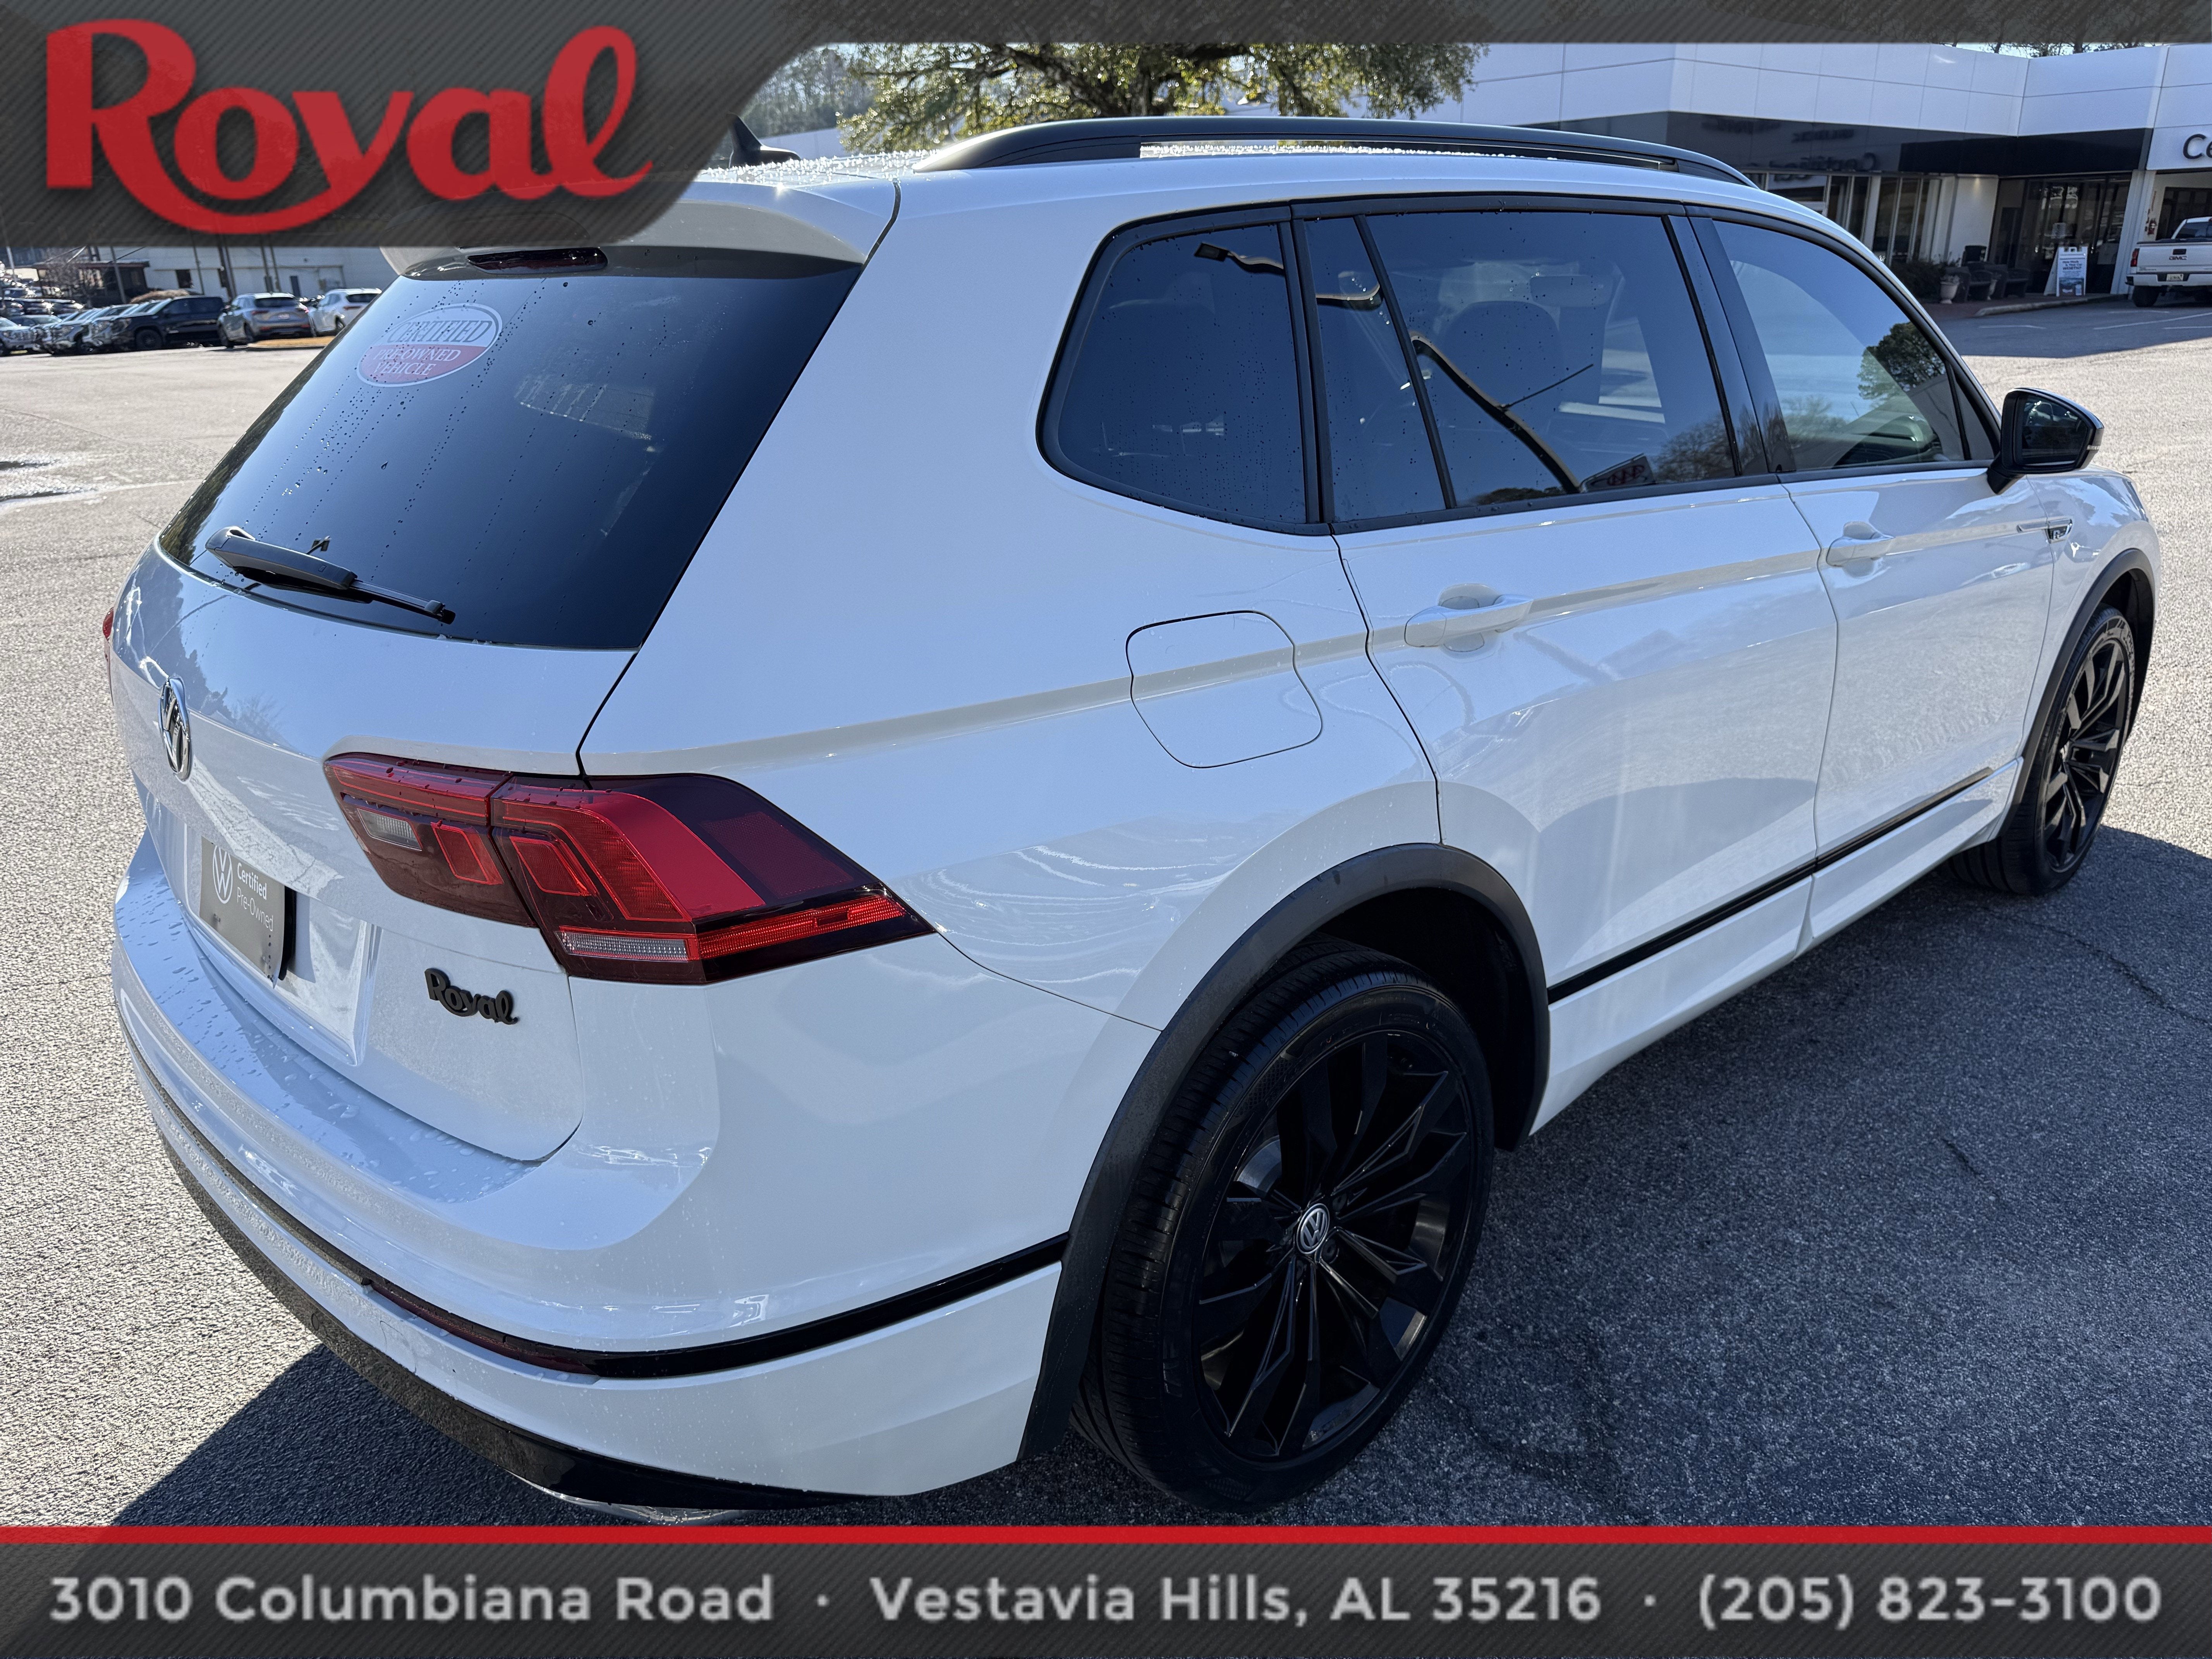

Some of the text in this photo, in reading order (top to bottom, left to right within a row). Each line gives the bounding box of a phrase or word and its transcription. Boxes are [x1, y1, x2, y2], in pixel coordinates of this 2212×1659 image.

[387, 320, 493, 343] CERTIFIED
[373, 349, 461, 362] PRE-OWNED
[373, 362, 436, 376] VEHICLE
[237, 862, 267, 900] Certified
[237, 886, 273, 931] Pre-Owned
[424, 968, 519, 1025] Royal
